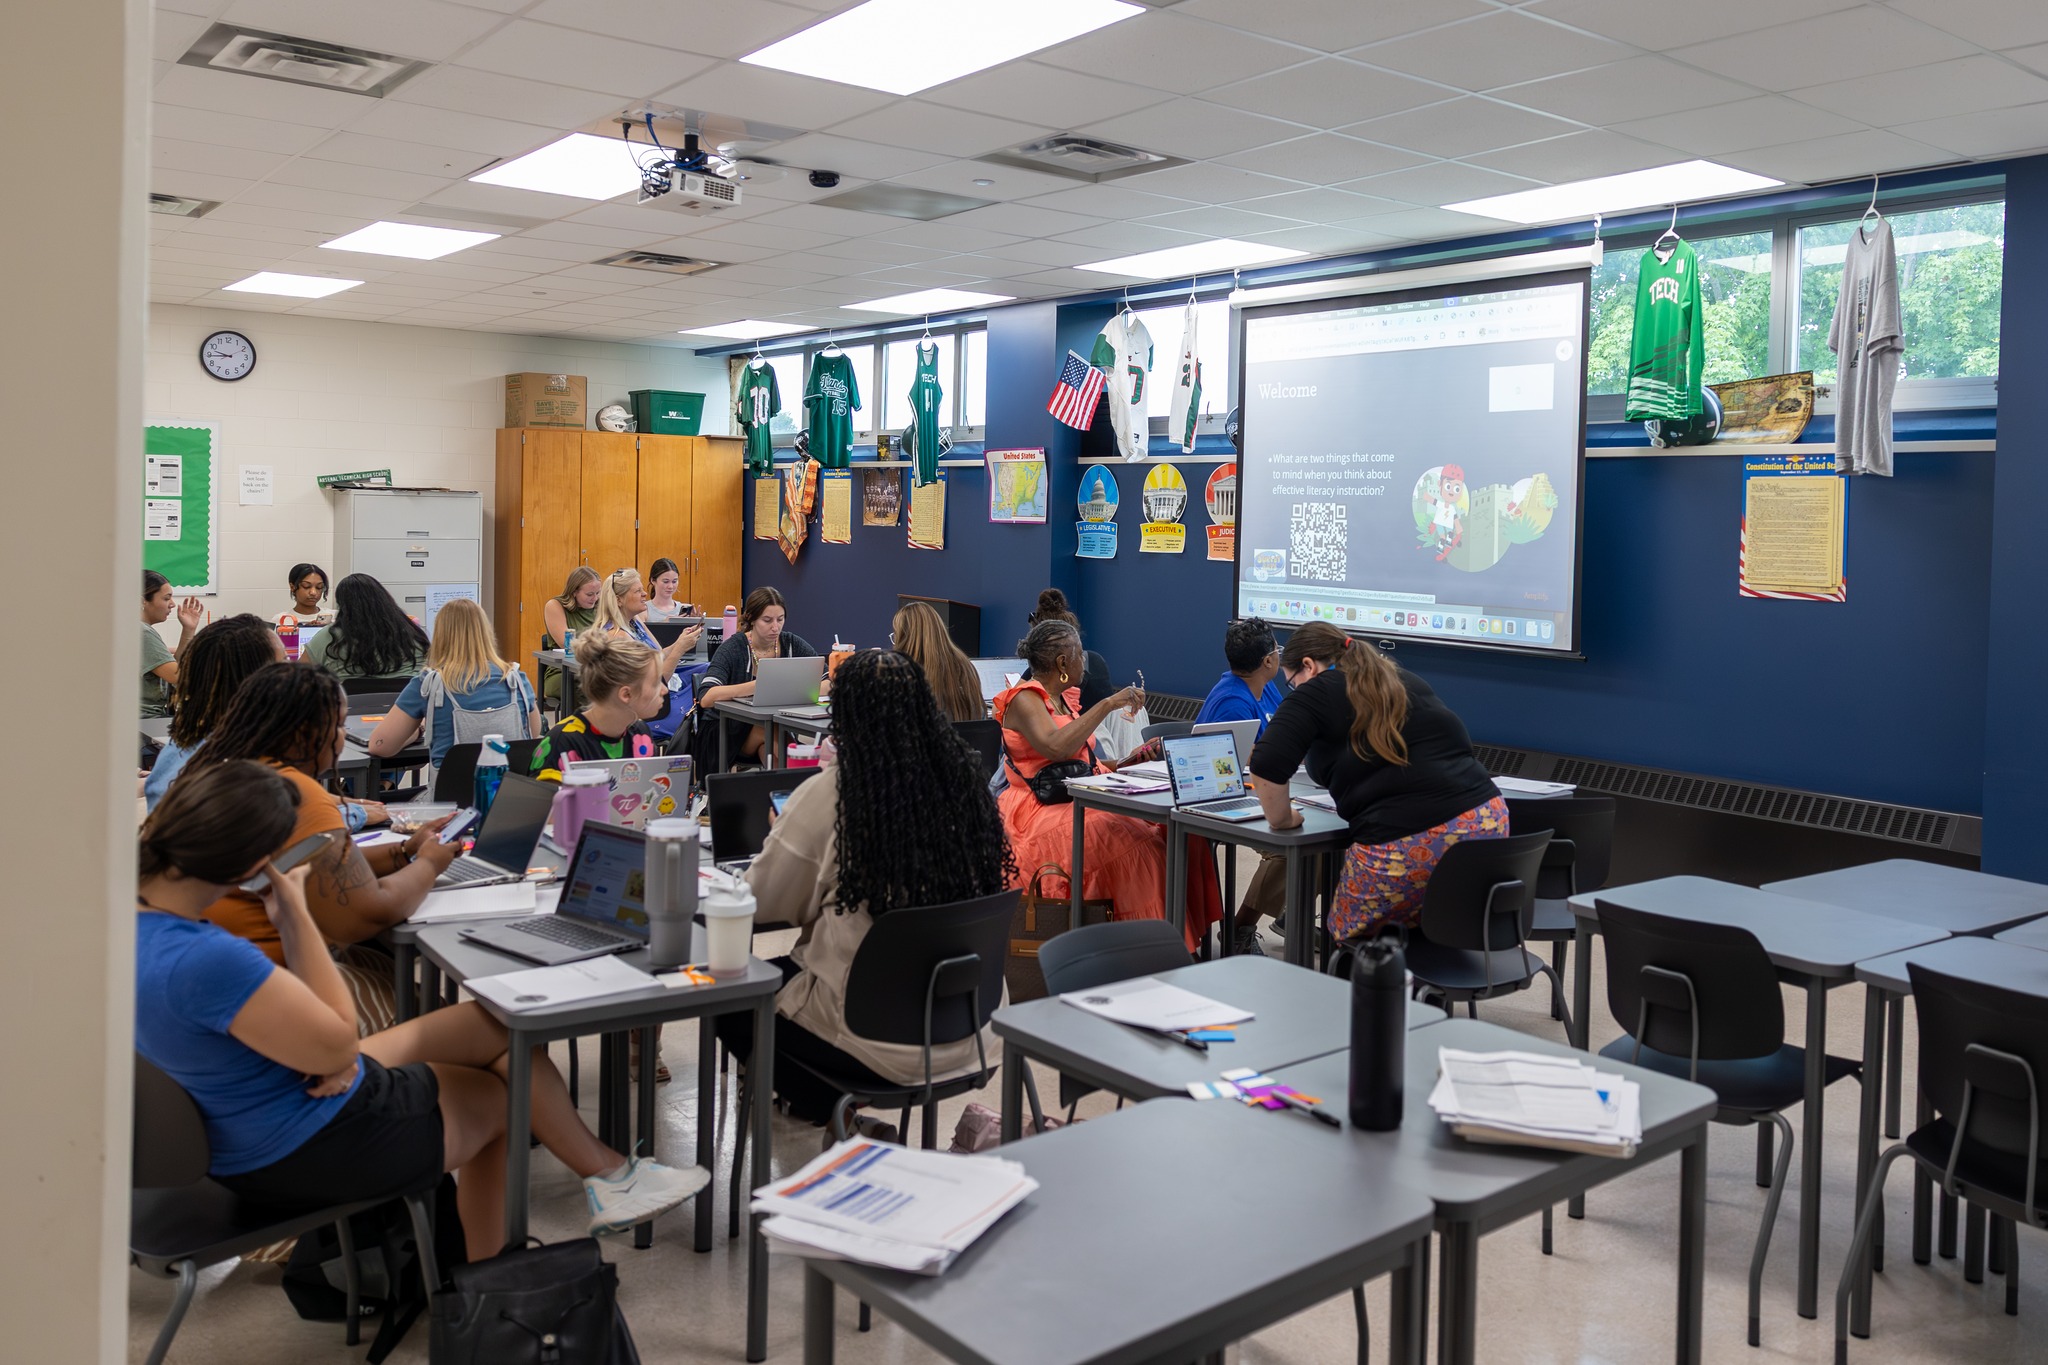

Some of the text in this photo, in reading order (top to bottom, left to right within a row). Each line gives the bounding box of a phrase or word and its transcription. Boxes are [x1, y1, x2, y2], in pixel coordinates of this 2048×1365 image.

[1649, 277, 1679, 305] TECH
[922, 374, 936, 384] TECH
[1258, 382, 1318, 400] Welcome
[832, 399, 846, 416] 15
[1273, 454, 1293, 463] What
[1310, 454, 1324, 463] two
[1326, 453, 1350, 465] things
[1352, 452, 1369, 462] that
[1371, 454, 1394, 462] come
[1273, 469, 1392, 482] to mind when you think about
[1272, 485, 1385, 498] effective literacy instruction?
